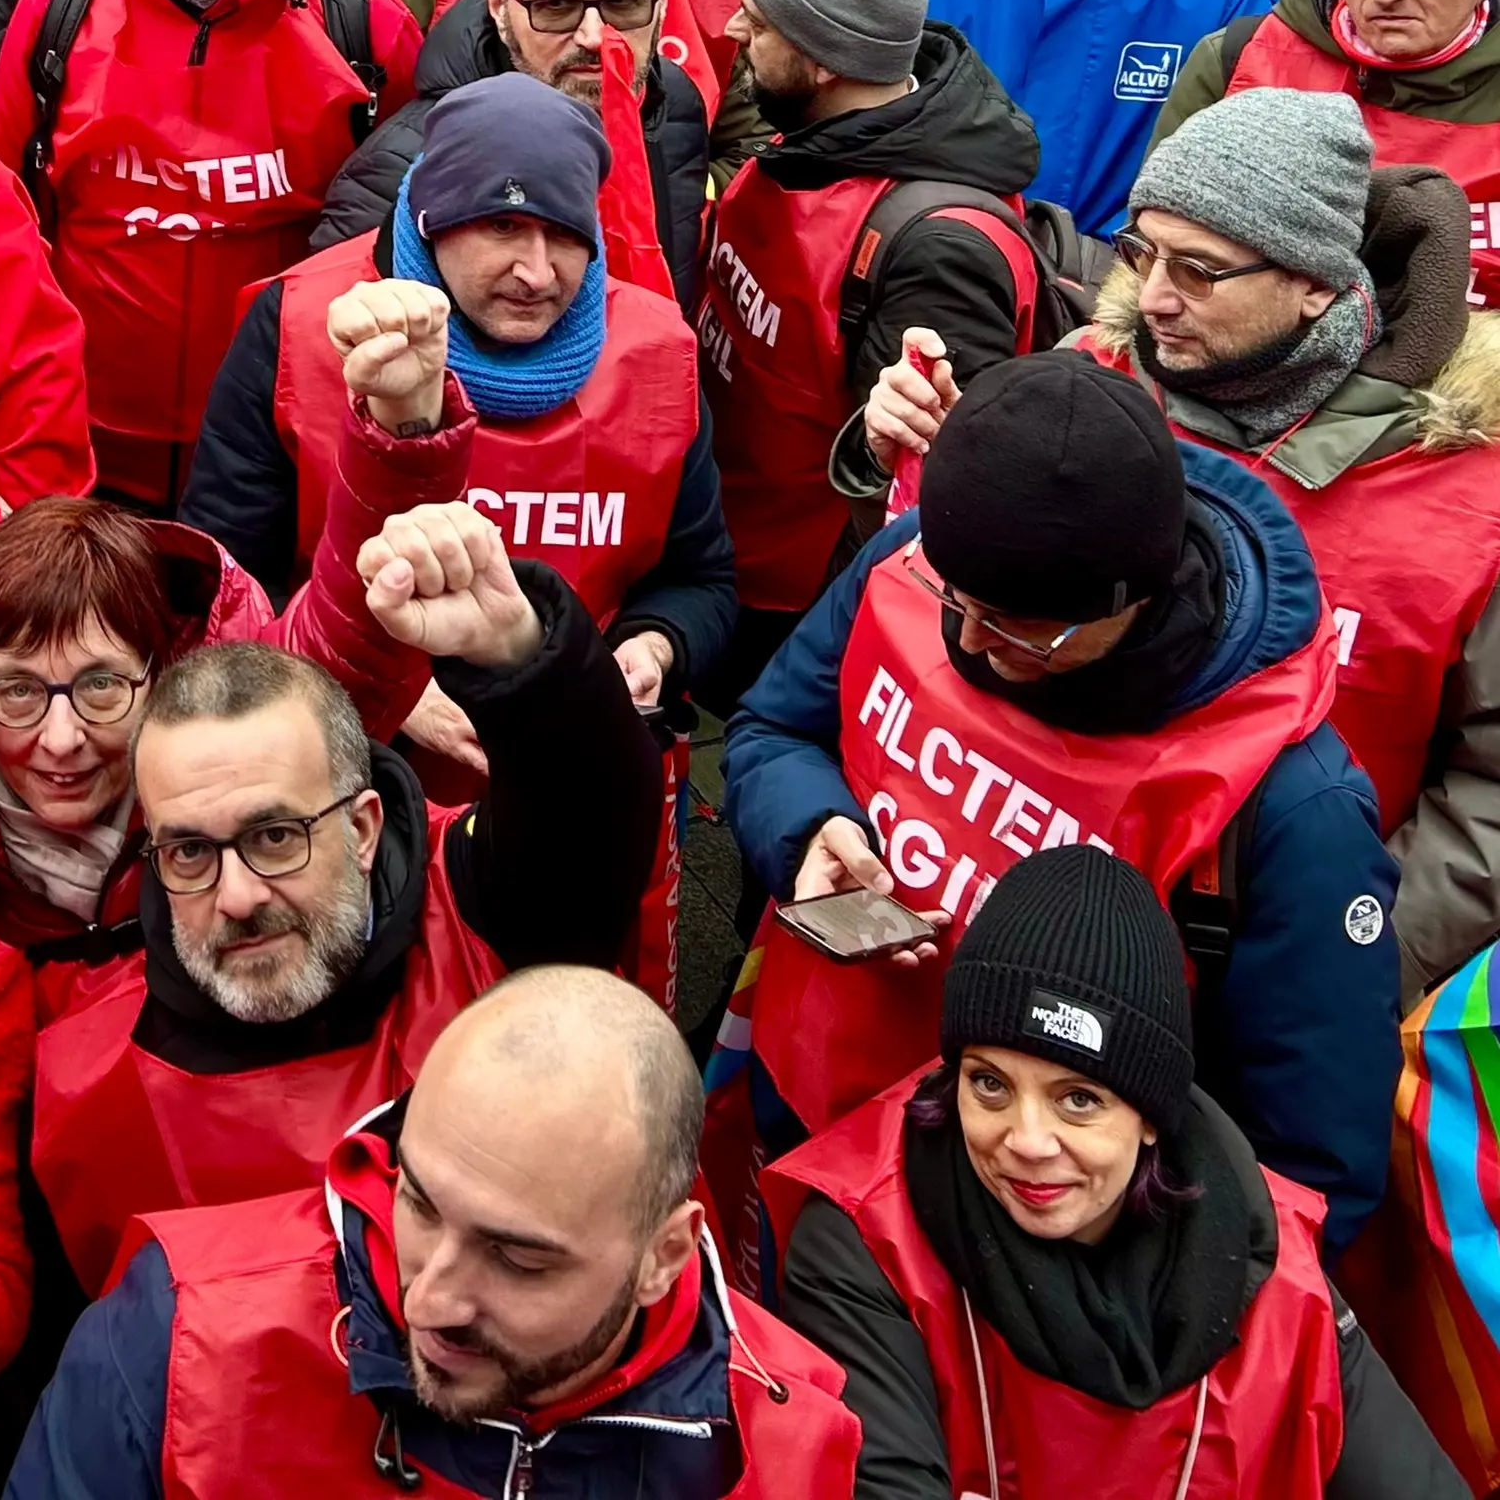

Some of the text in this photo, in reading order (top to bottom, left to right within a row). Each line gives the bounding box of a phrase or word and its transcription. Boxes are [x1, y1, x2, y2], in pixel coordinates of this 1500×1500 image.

[1119, 70, 1170, 88] ACLVB
[1032, 1006, 1082, 1031] NORTH
[1057, 1002, 1083, 1020] THE
[1044, 1021, 1080, 1043] FACE
